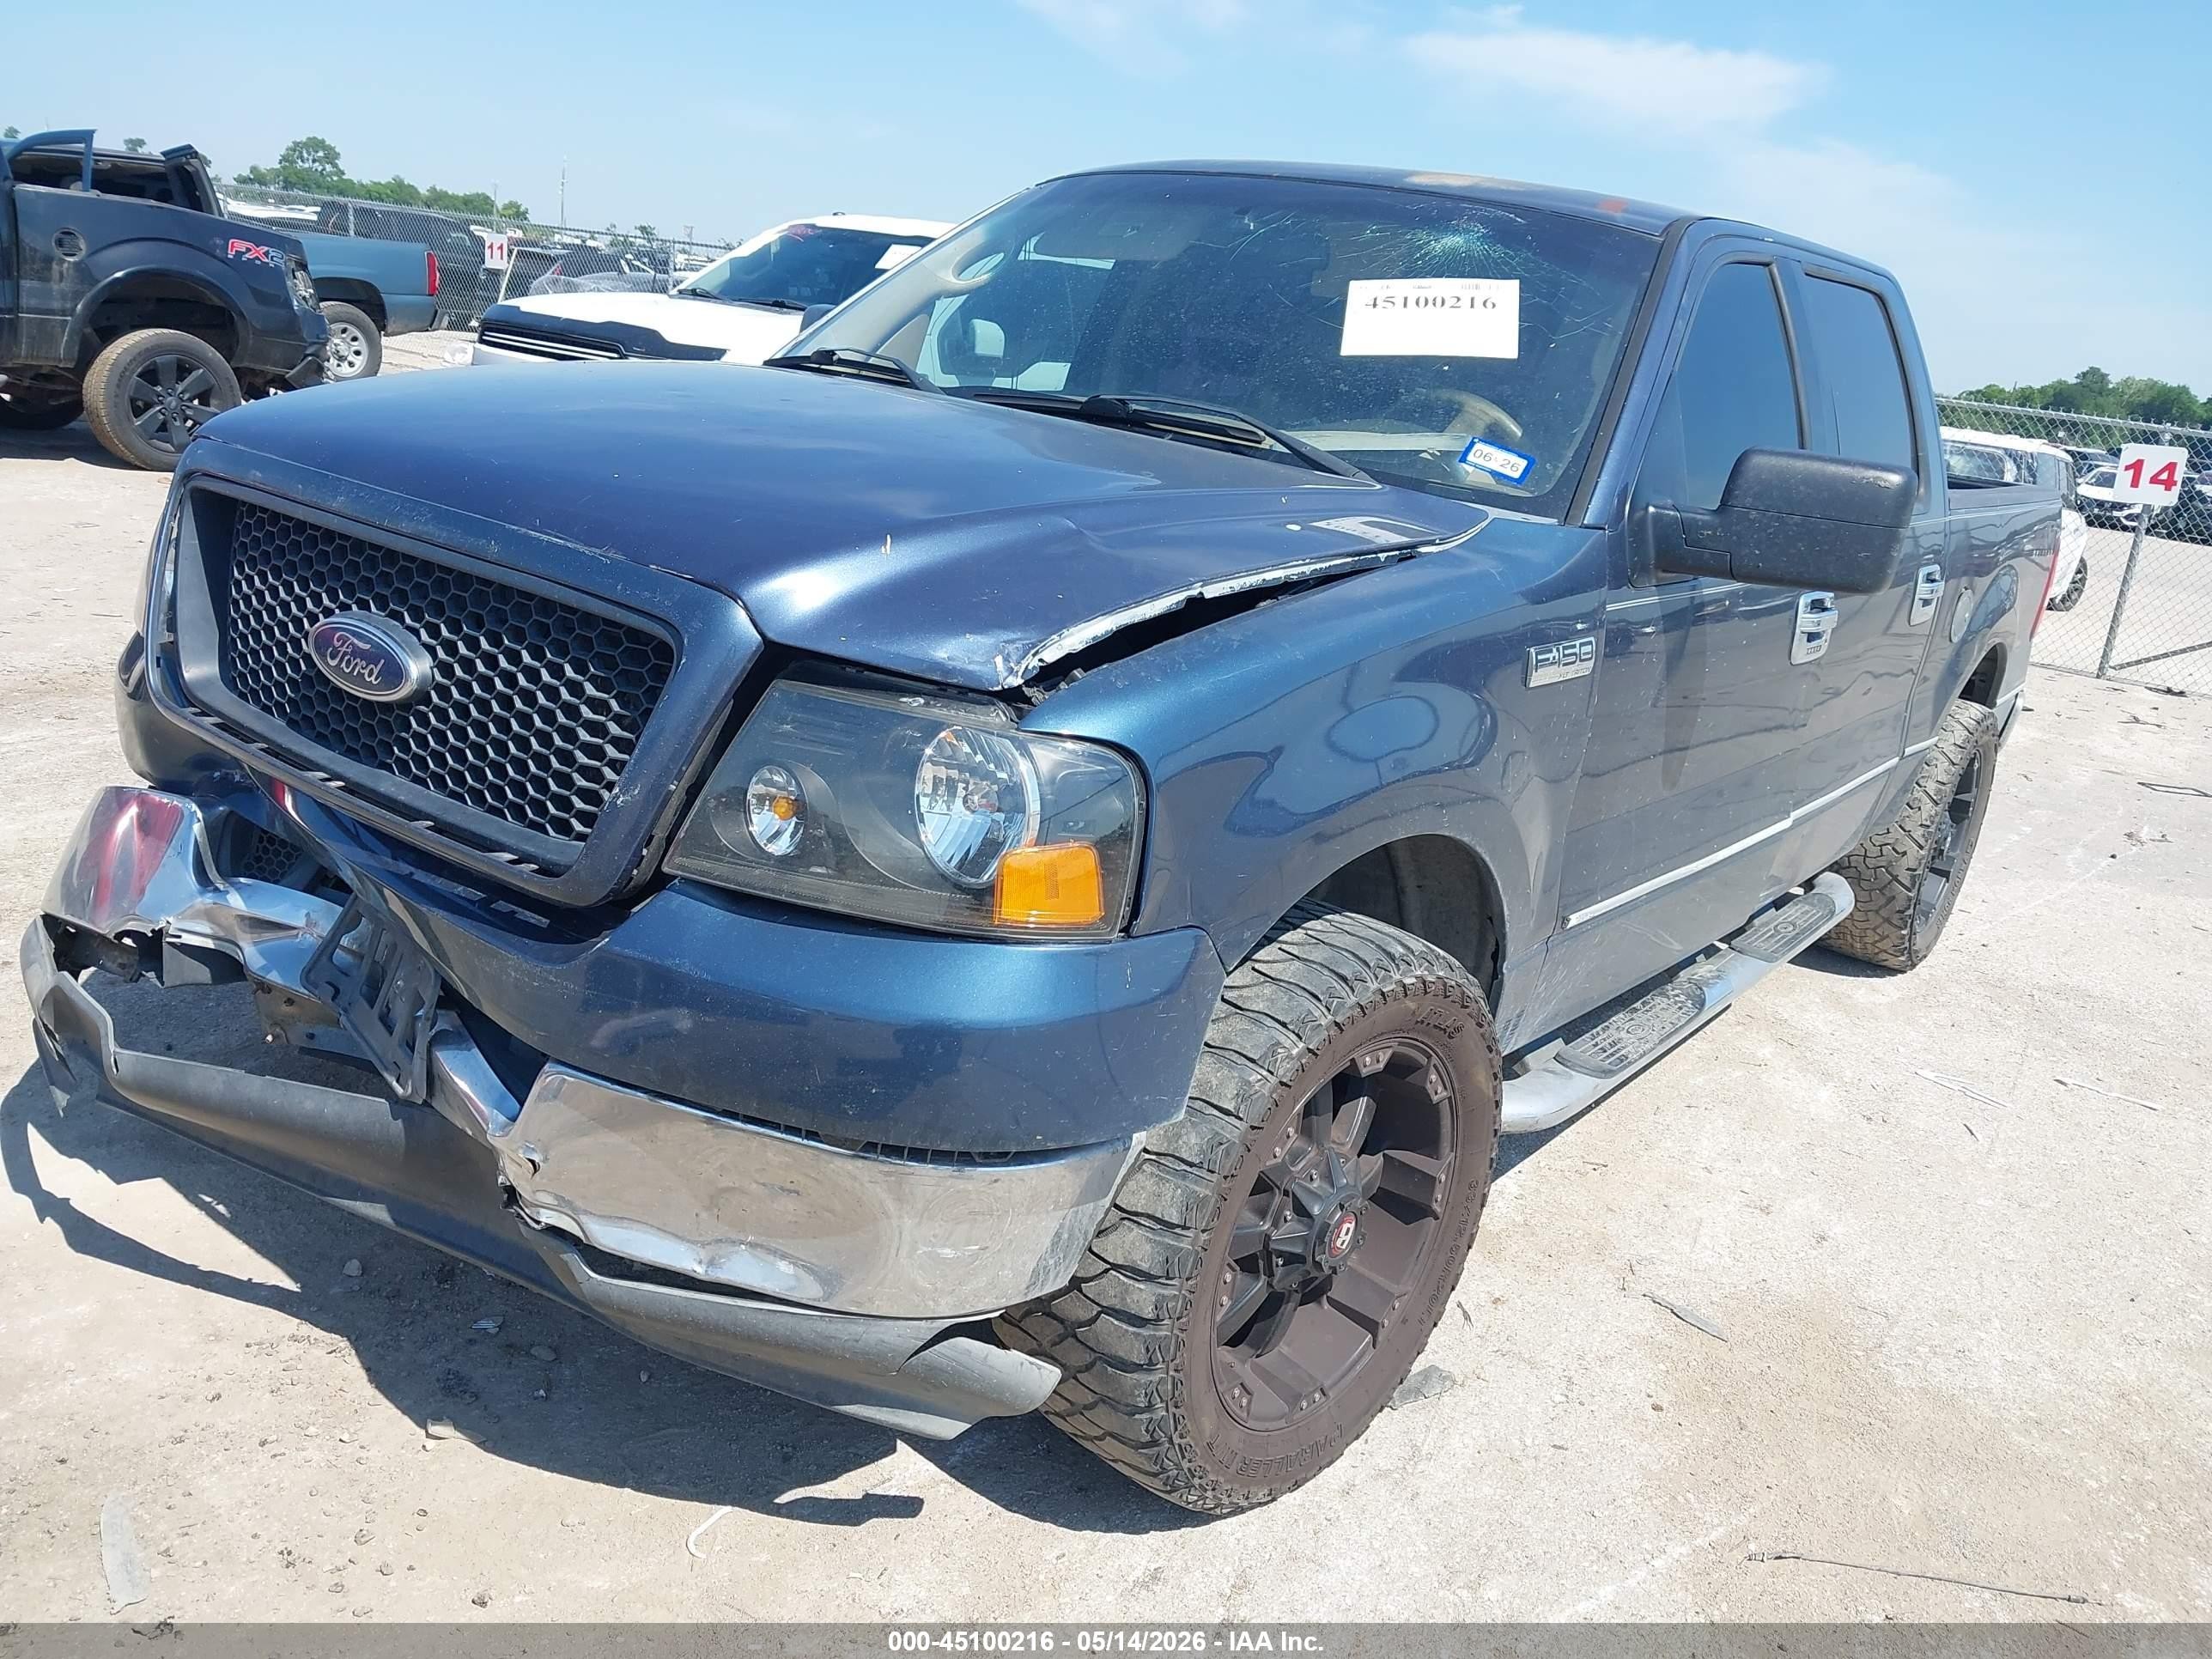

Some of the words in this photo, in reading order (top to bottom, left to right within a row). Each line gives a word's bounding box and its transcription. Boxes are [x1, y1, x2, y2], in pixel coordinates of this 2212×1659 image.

[228, 239, 286, 268] FX2
[487, 241, 504, 261] 11
[1364, 295, 1497, 309] 45100216
[2124, 459, 2179, 492] 14
[326, 631, 386, 685] Ford
